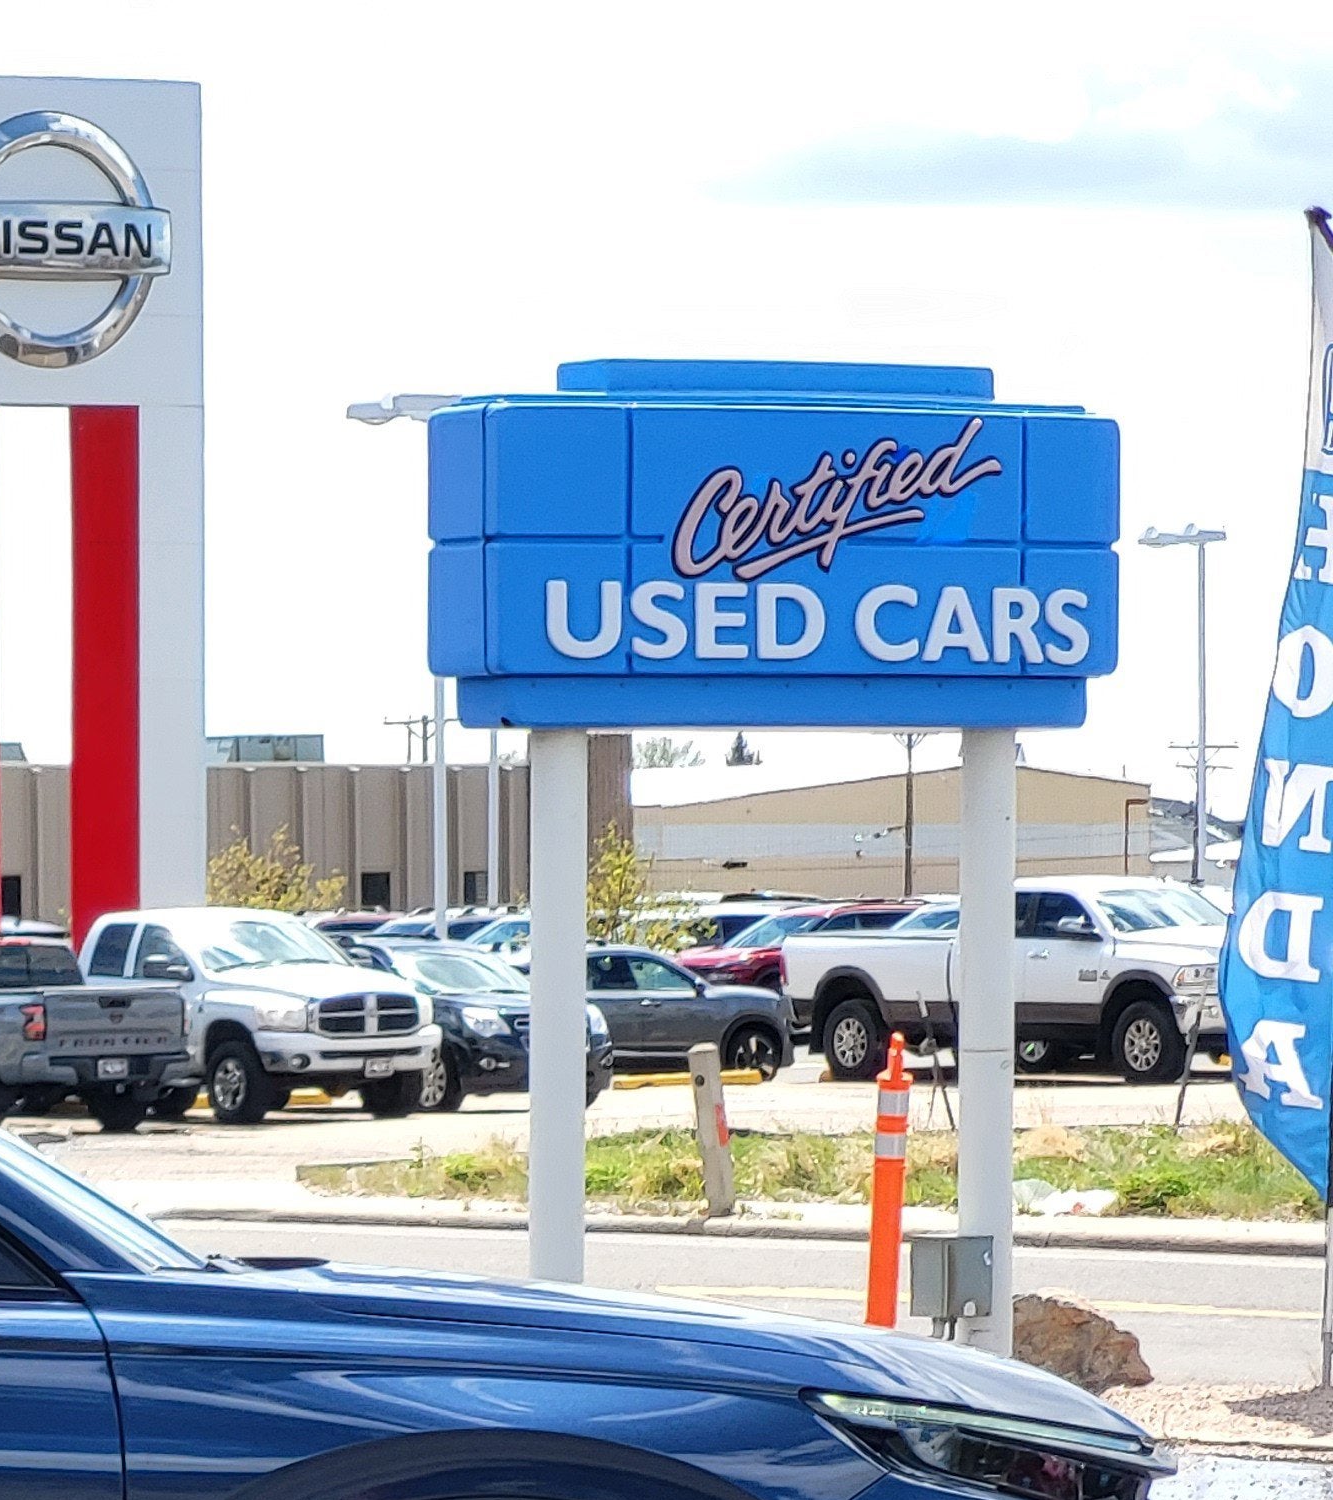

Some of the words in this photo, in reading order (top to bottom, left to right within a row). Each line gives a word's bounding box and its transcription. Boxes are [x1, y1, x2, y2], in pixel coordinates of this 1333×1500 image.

[671, 418, 1003, 578] Certified
[544, 579, 826, 661] USED
[855, 584, 1090, 665] CARS
